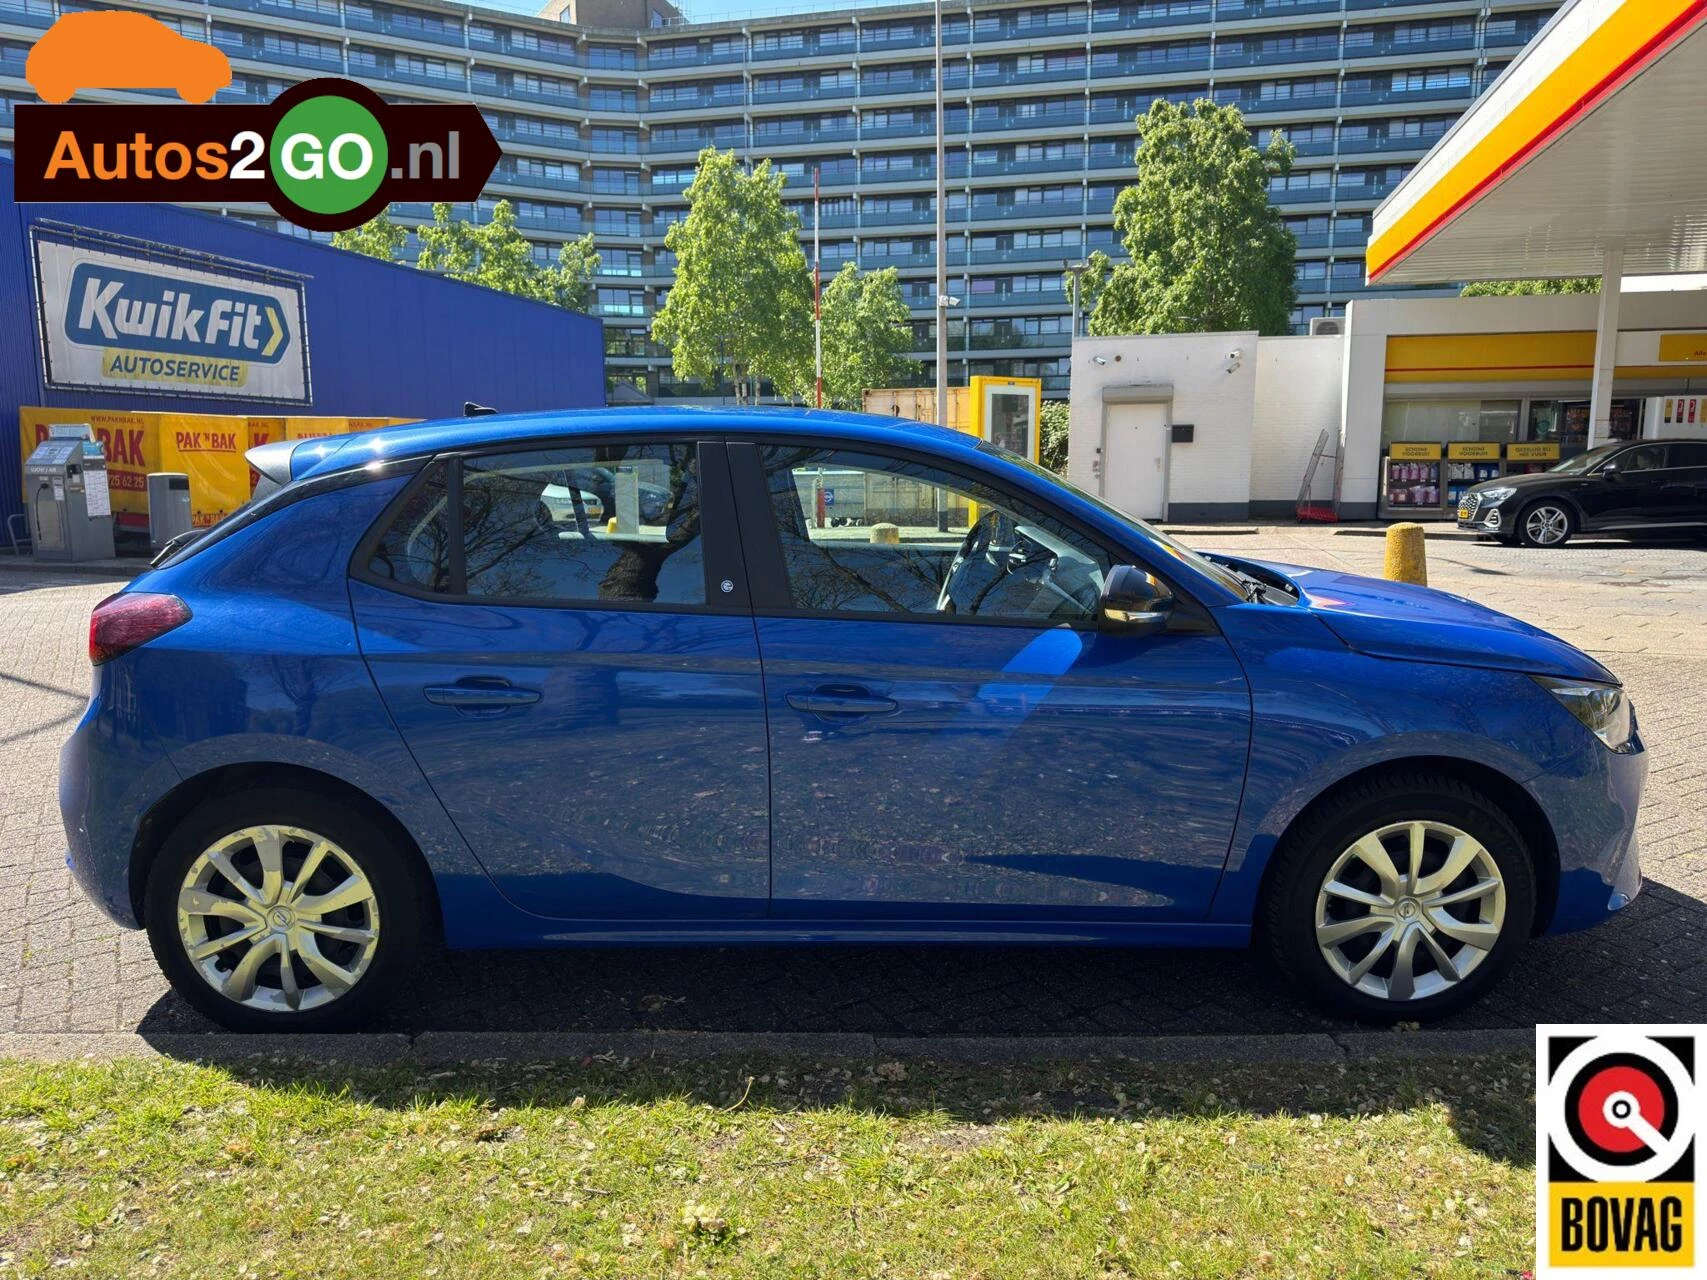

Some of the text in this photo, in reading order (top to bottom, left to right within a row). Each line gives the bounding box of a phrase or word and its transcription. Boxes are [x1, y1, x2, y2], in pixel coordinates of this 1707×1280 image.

[78, 277, 204, 343] Kwik
[110, 355, 240, 382] AUTOSERVICE
[176, 431, 202, 449] PAK
[211, 432, 237, 449] BAK
